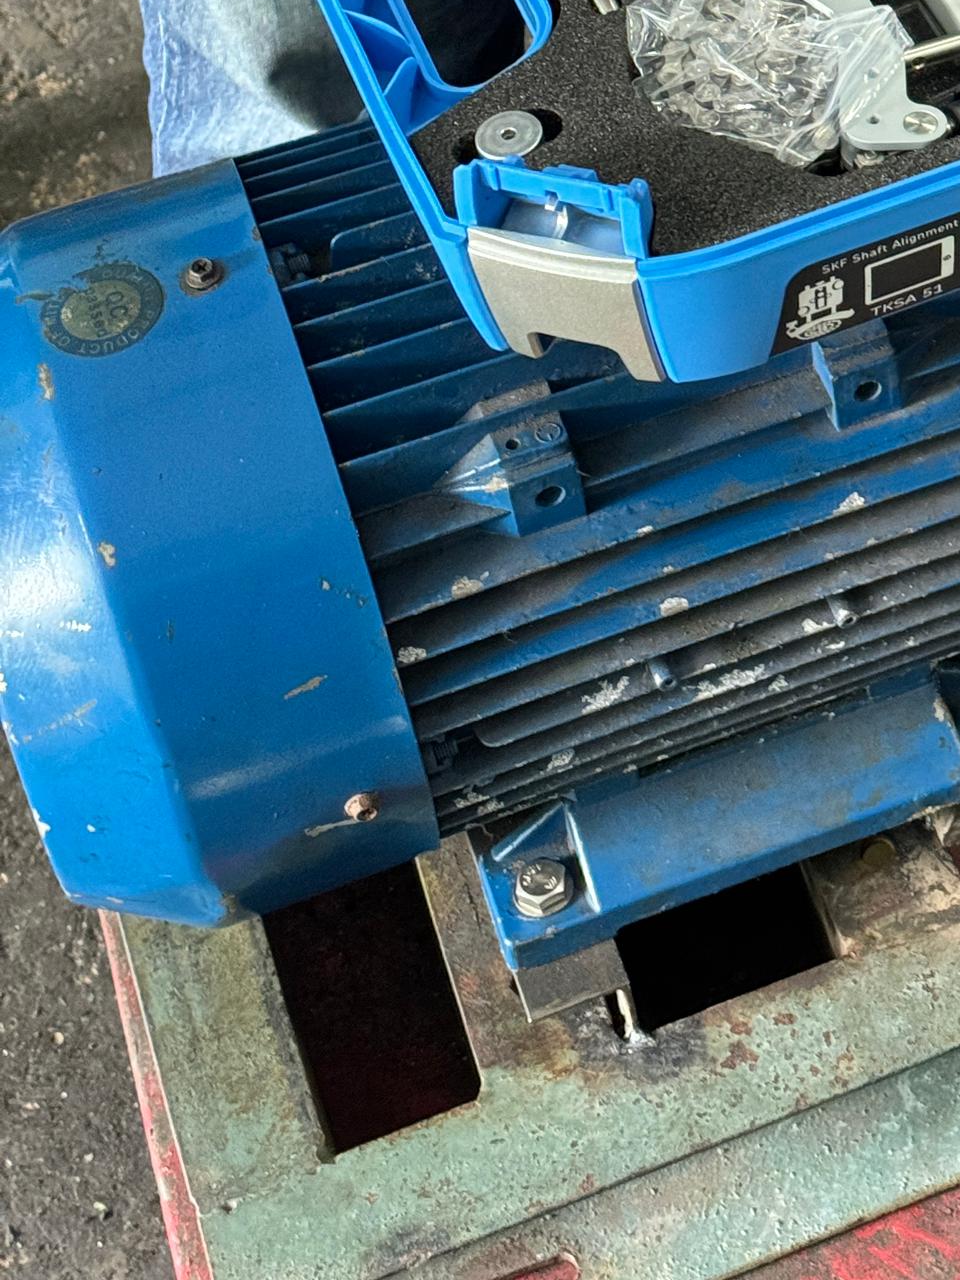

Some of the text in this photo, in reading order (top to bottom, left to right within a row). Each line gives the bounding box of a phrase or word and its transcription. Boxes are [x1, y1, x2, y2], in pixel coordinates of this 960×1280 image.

[821, 257, 848, 275] SKF
[852, 244, 888, 265] Shaft
[892, 219, 959, 251] Alignment
[870, 283, 944, 317] TKSA 51
